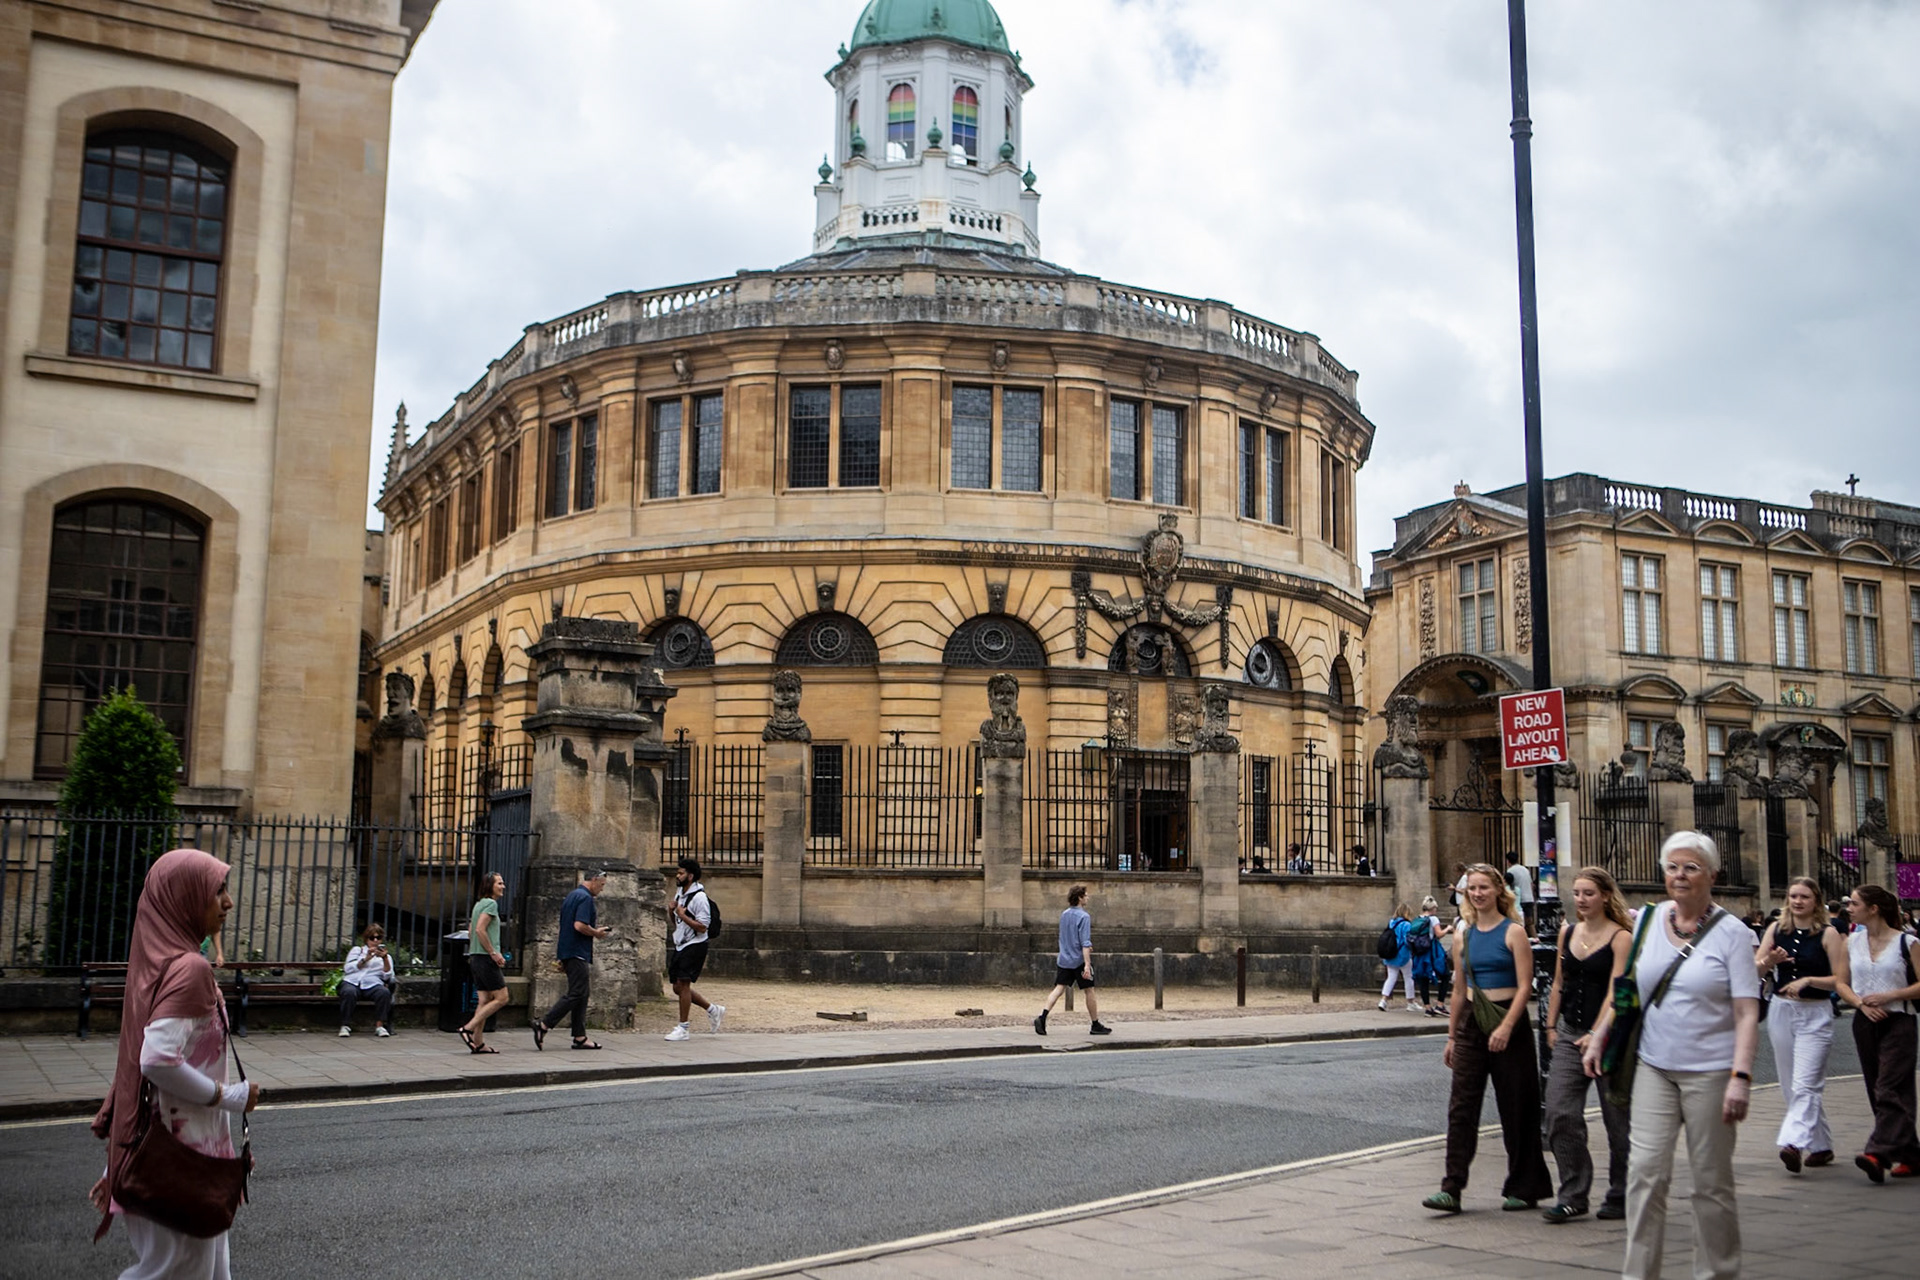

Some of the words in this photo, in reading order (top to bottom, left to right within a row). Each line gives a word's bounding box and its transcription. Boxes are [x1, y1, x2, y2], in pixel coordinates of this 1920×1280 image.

[1515, 695, 1547, 712] NEW
[1513, 712, 1552, 730] ROAD
[1508, 727, 1560, 747] LAYOUT
